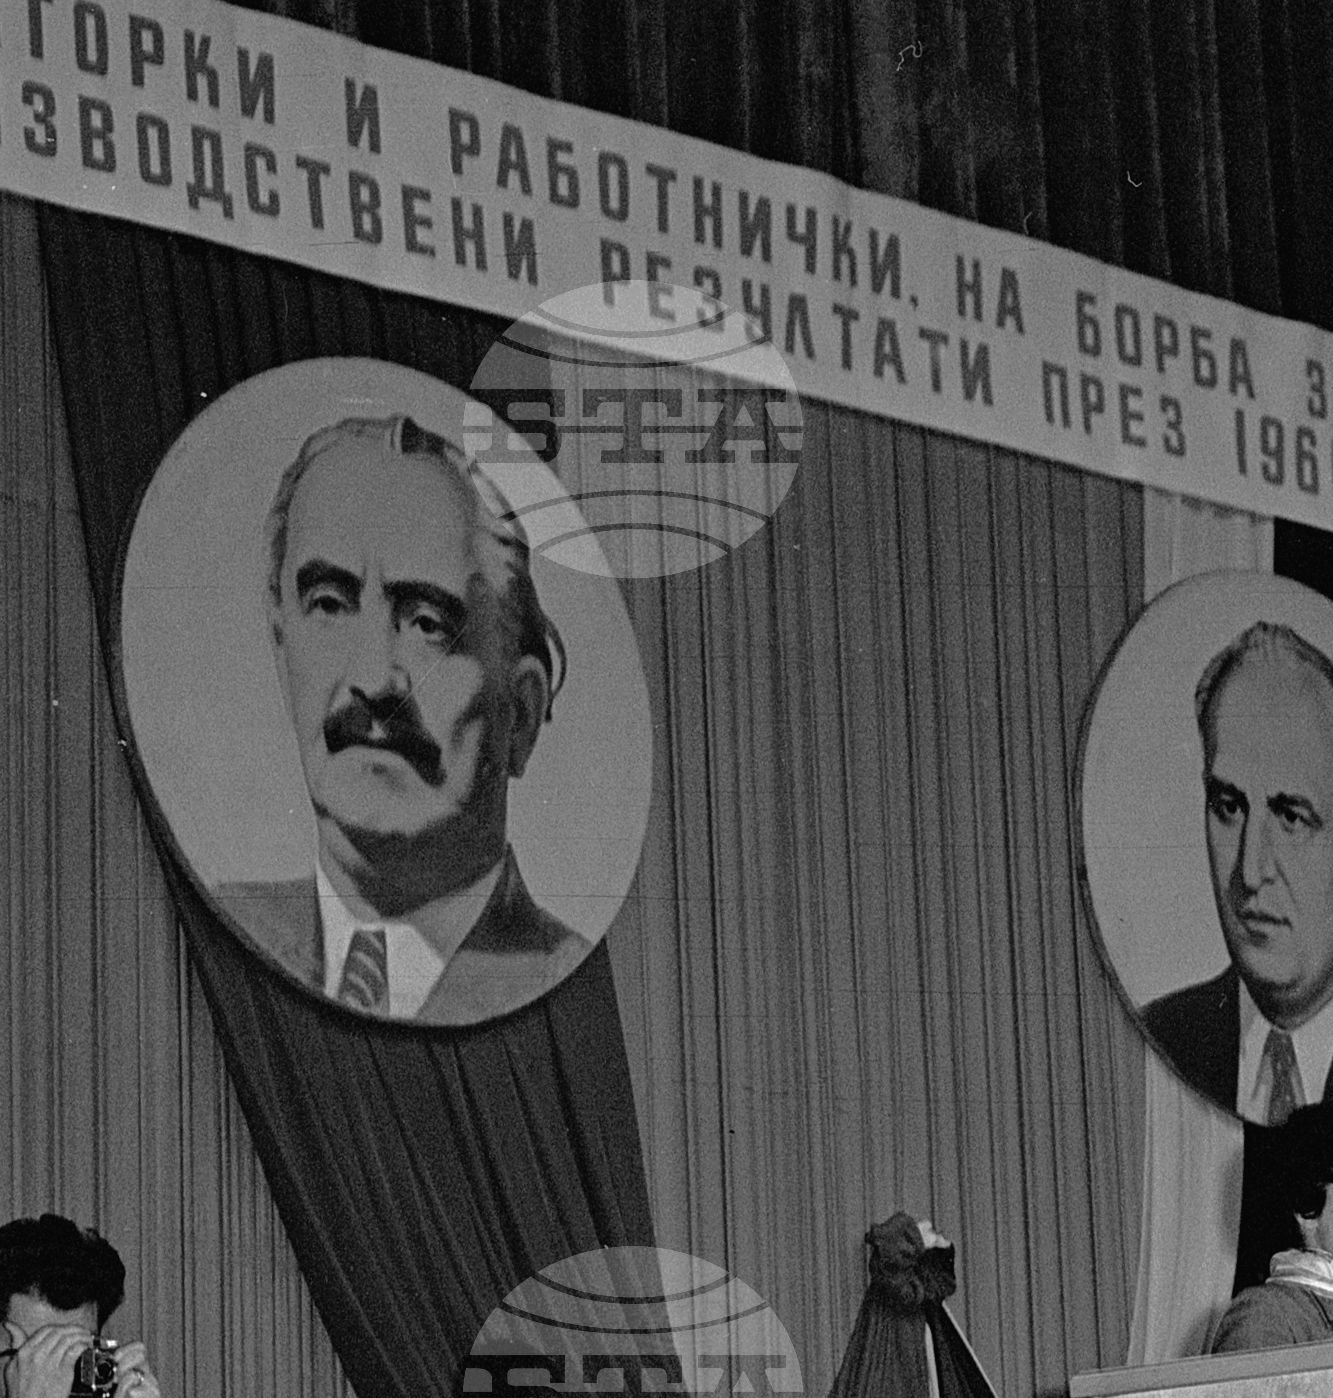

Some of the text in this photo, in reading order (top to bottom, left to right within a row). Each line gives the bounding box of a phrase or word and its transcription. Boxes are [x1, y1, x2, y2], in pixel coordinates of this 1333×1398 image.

[345, 77, 381, 154] И
[956, 255, 1025, 335] НА
[1076, 290, 1255, 399] БОРБА
[600, 238, 993, 406] РЕЗУЛТАТИ
[1042, 361, 1186, 457] ПРЕЗ
